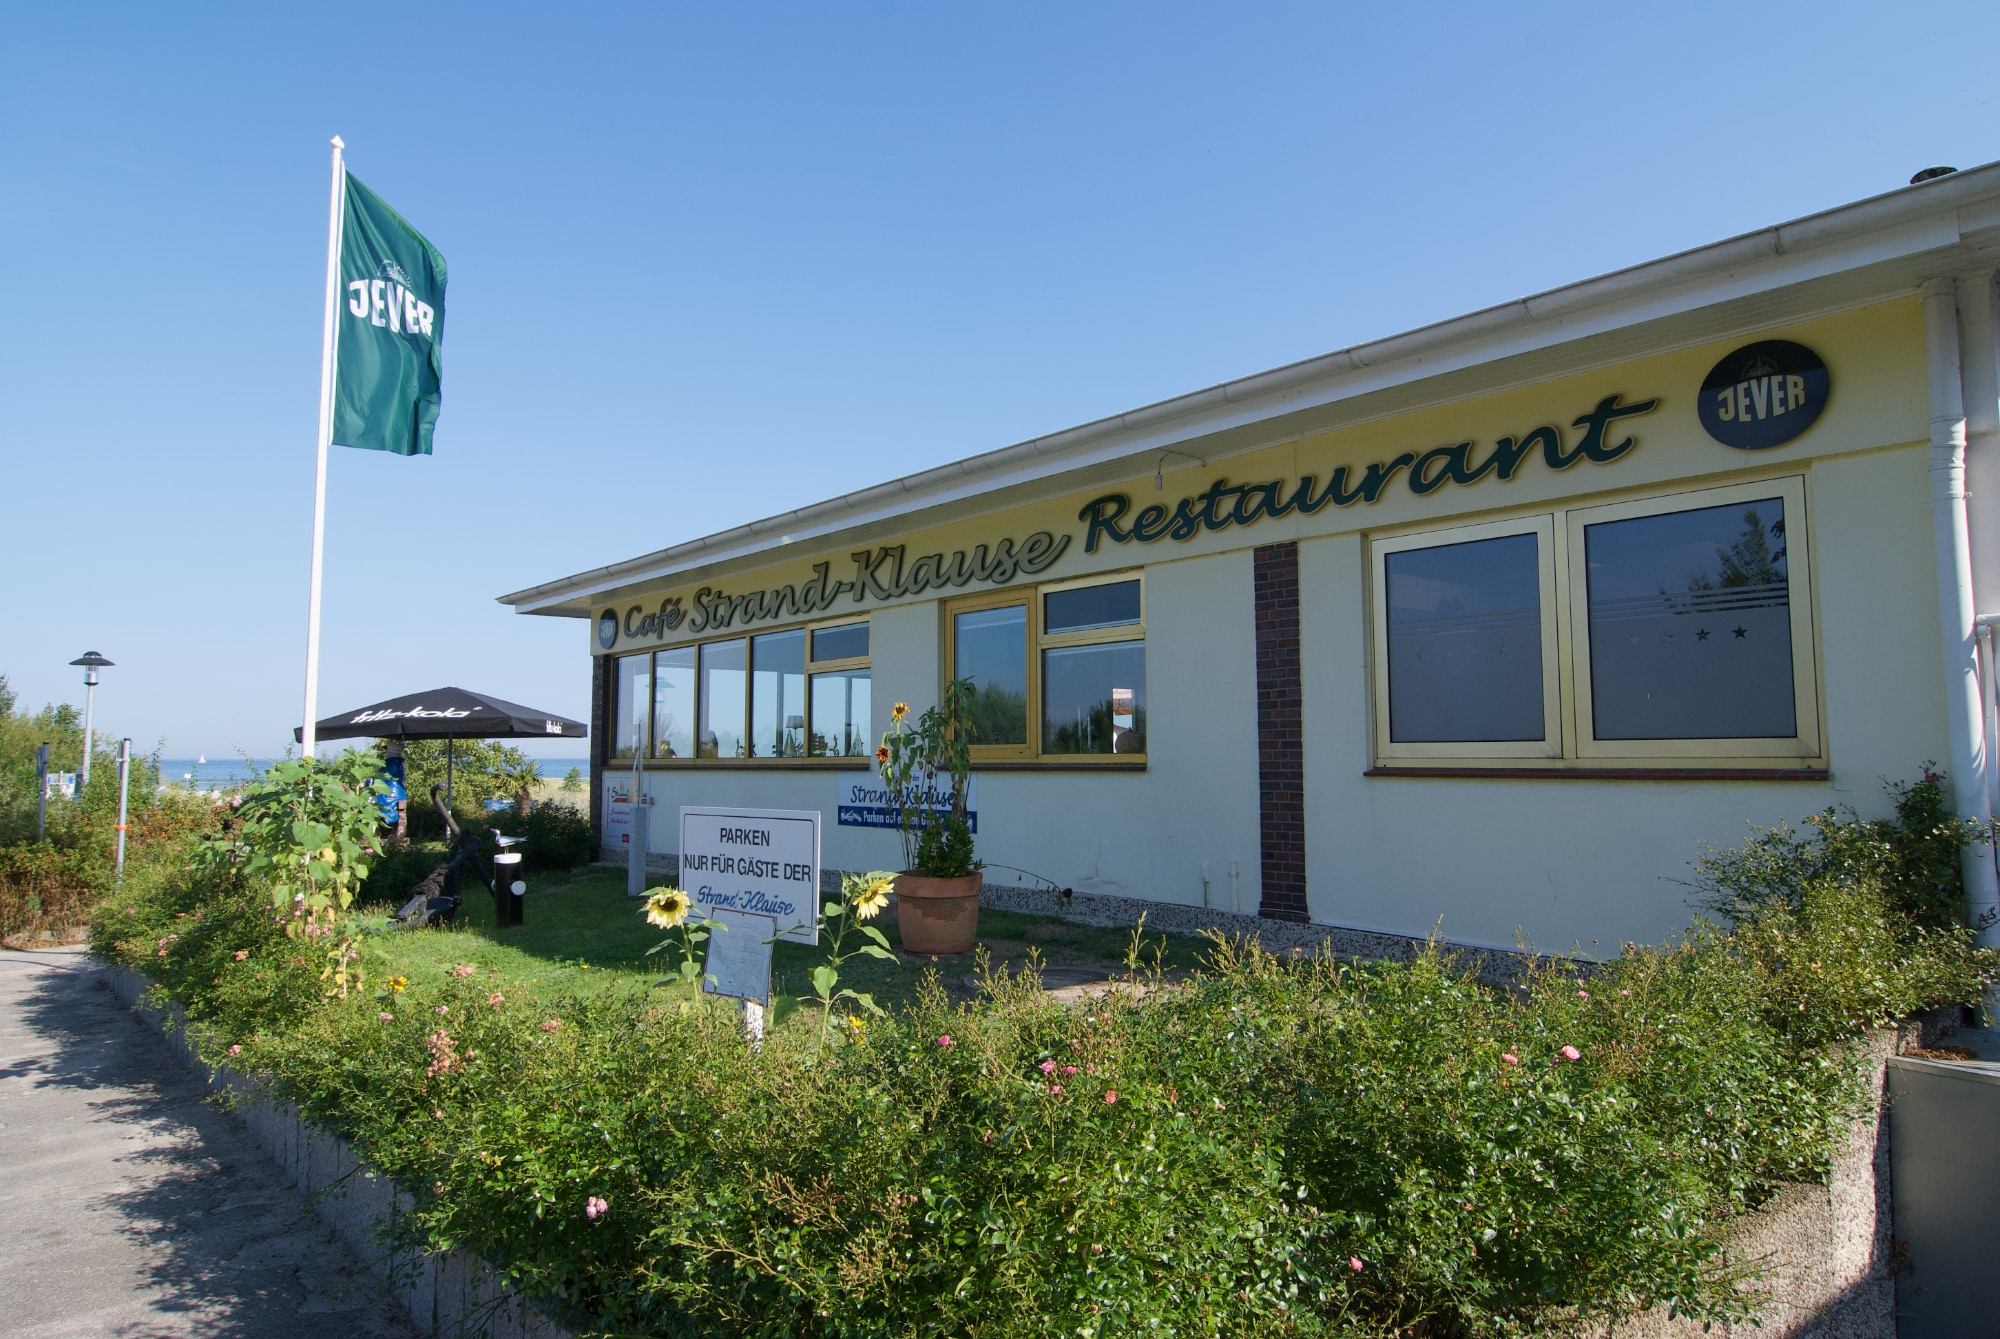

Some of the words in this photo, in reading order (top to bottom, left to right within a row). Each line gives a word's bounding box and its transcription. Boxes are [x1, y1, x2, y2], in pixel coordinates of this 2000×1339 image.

[349, 279, 435, 337] JEVER
[1717, 374, 1806, 423] JEVER
[623, 596, 688, 640] Café
[687, 530, 1071, 634] Strand-Klause
[1076, 391, 1662, 556] Restaurant
[863, 810, 884, 824] Parken
[719, 827, 771, 847] PARKEN
[684, 853, 708, 872] NUR
[711, 853, 735, 874] FÜR
[737, 856, 779, 879] GÄSTE
[783, 863, 812, 883] DER
